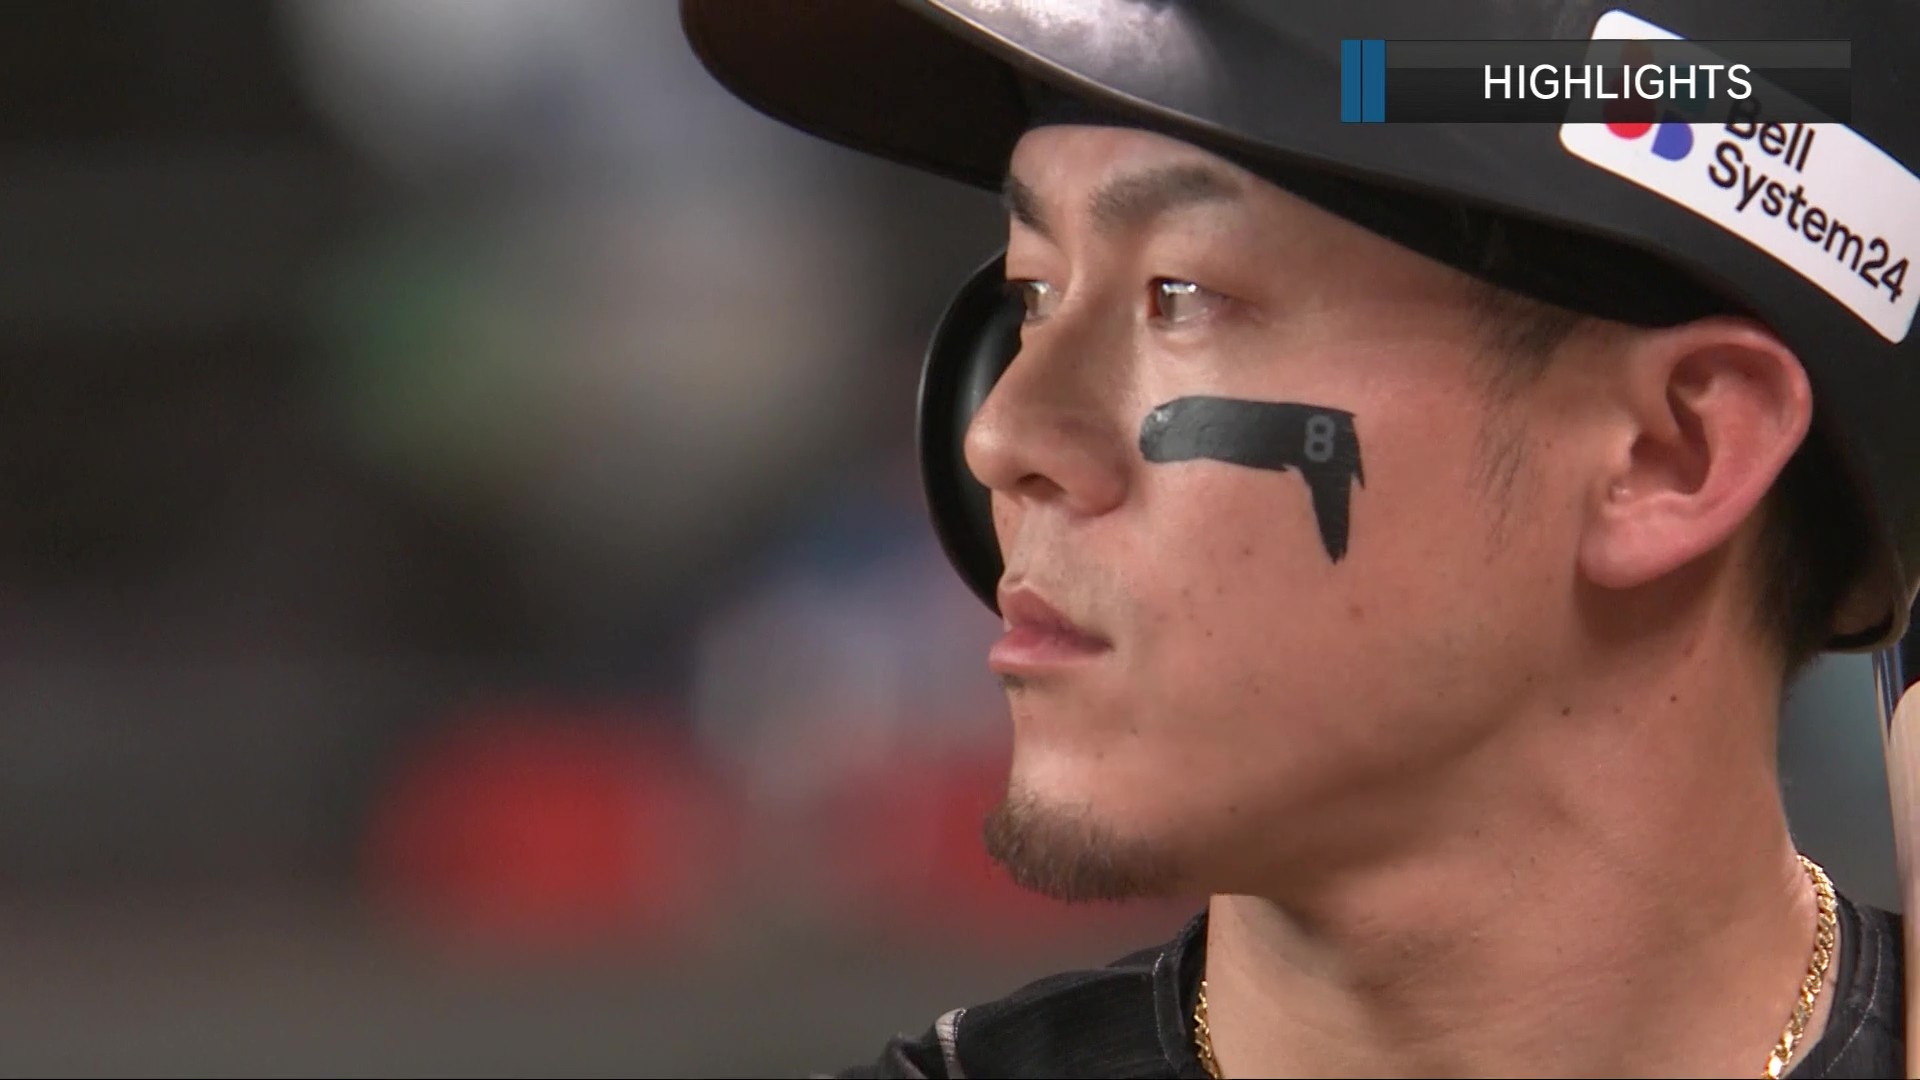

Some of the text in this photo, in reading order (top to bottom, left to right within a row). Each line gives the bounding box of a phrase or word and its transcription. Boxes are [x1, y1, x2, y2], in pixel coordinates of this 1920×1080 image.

[1724, 97, 1815, 172] Bell
[1708, 141, 1909, 303] System24
[1305, 414, 1335, 462] 8
